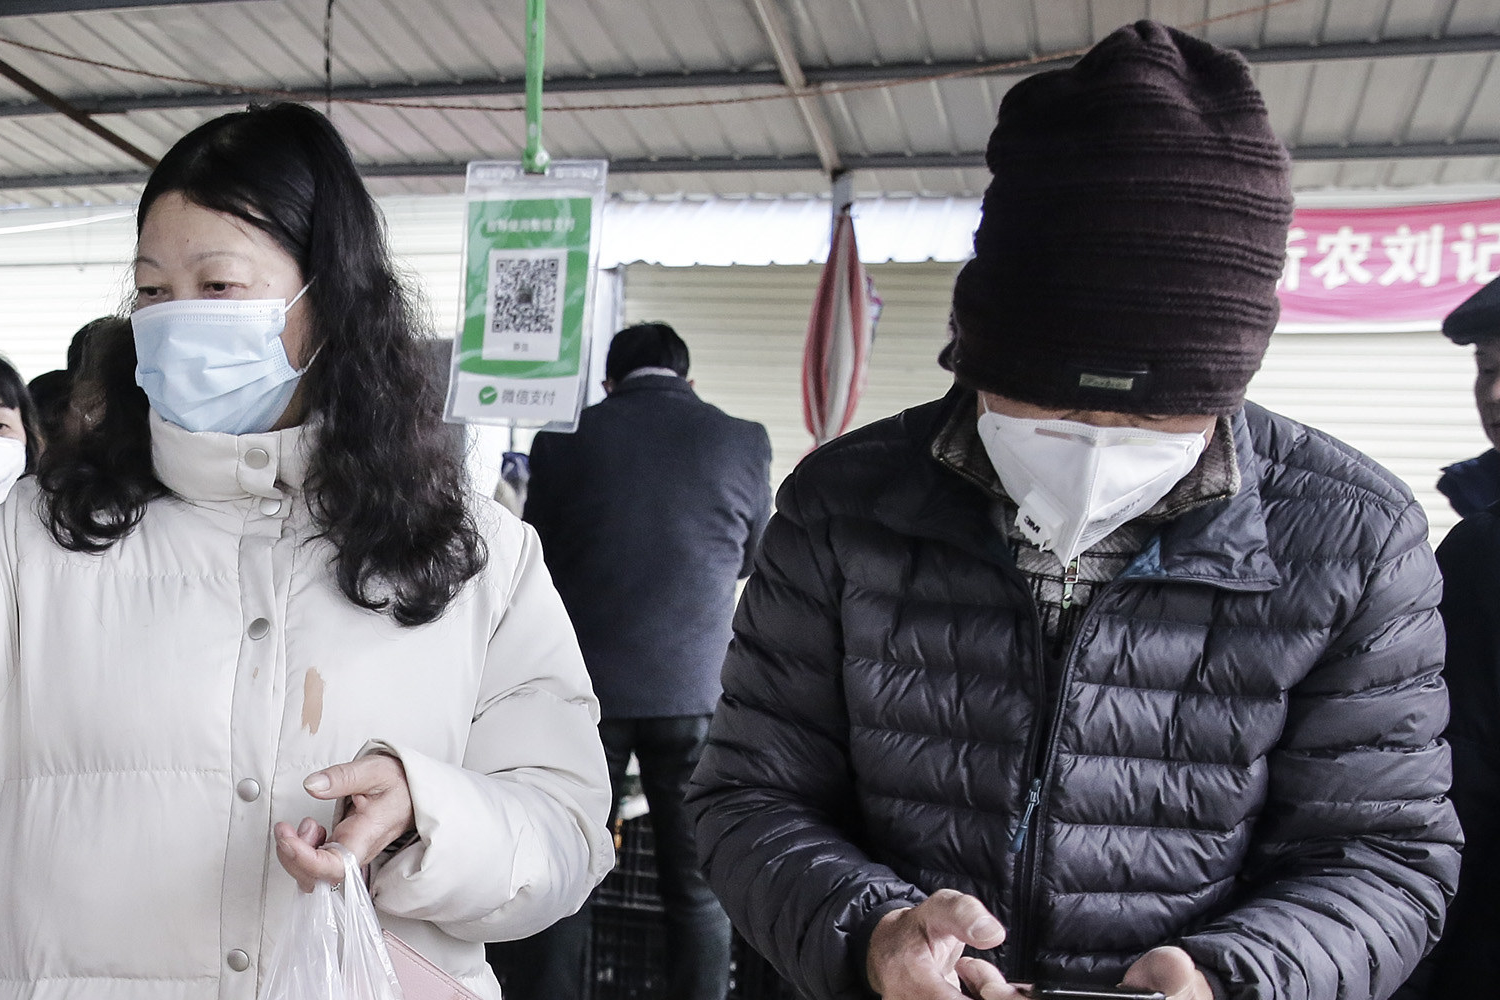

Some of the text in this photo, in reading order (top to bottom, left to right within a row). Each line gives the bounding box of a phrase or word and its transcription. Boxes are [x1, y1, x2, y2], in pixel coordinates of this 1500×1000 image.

[501, 389, 556, 406] 微信支付
[1023, 514, 1042, 534] 3M
